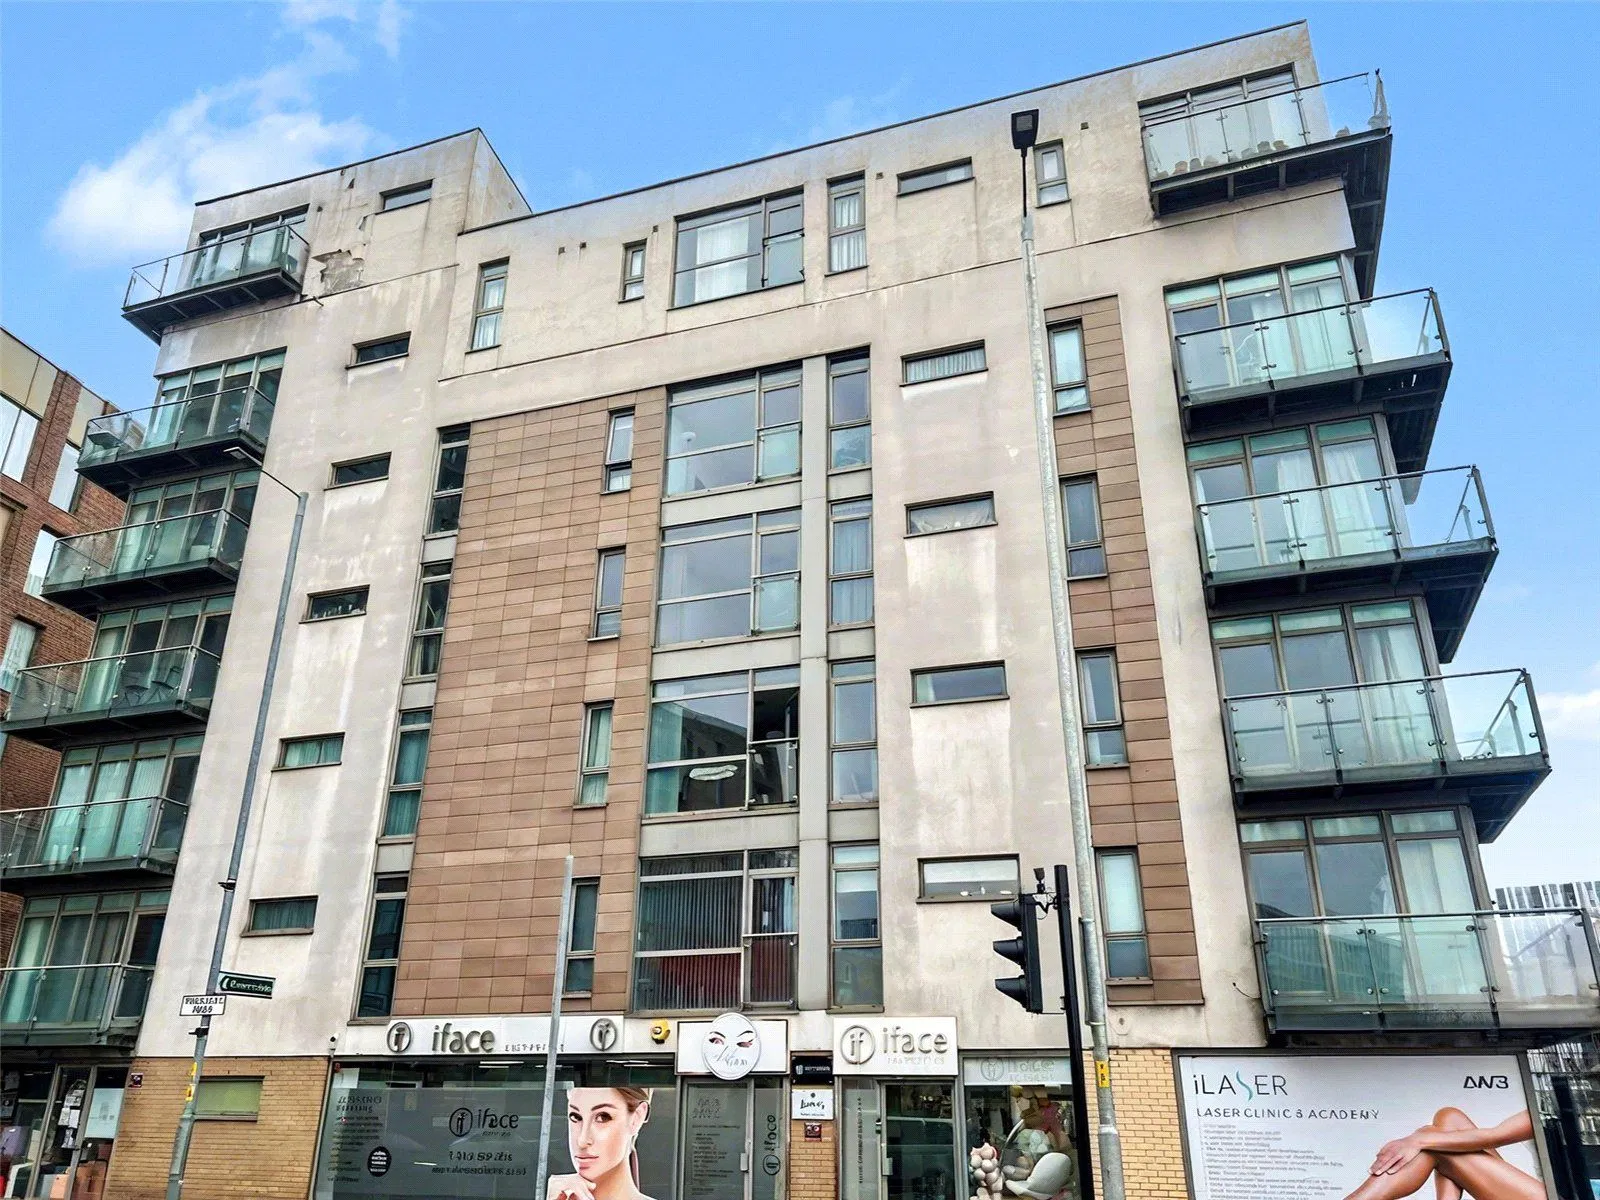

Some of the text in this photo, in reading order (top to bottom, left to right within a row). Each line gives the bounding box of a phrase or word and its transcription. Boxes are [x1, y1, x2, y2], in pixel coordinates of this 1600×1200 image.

[432, 1023, 496, 1053] iface
[883, 1026, 948, 1054] iface
[1193, 1070, 1288, 1101] iLASER
[478, 1108, 519, 1129] iface
[1197, 1108, 1240, 1118] LASER
[1244, 1108, 1293, 1119] CLINIC
